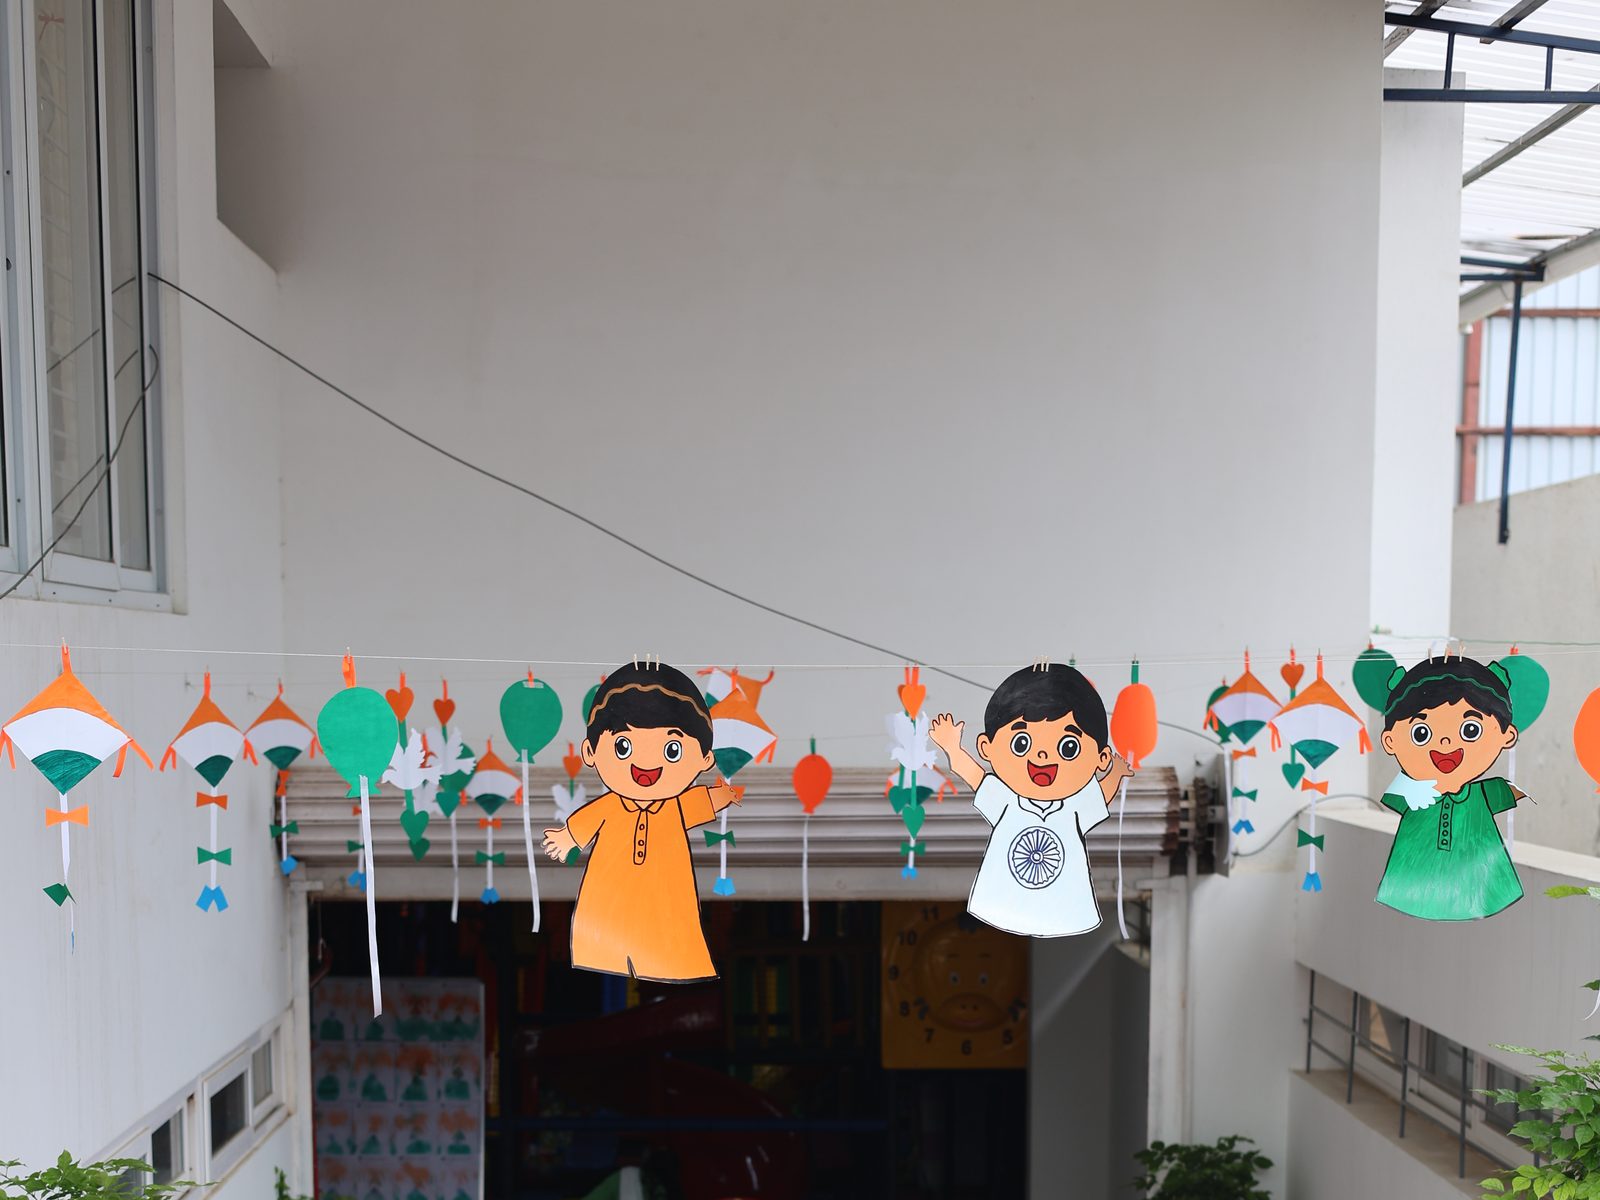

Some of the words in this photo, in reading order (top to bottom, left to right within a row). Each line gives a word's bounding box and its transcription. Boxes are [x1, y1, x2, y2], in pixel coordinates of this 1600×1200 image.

[921, 905, 940, 921] 11
[899, 930, 917, 945] 10
[888, 964, 898, 980] 9
[900, 1000, 910, 1016] 8
[924, 1028, 935, 1044] 7
[1003, 1028, 1012, 1045] 5
[961, 1039, 972, 1055] 6
